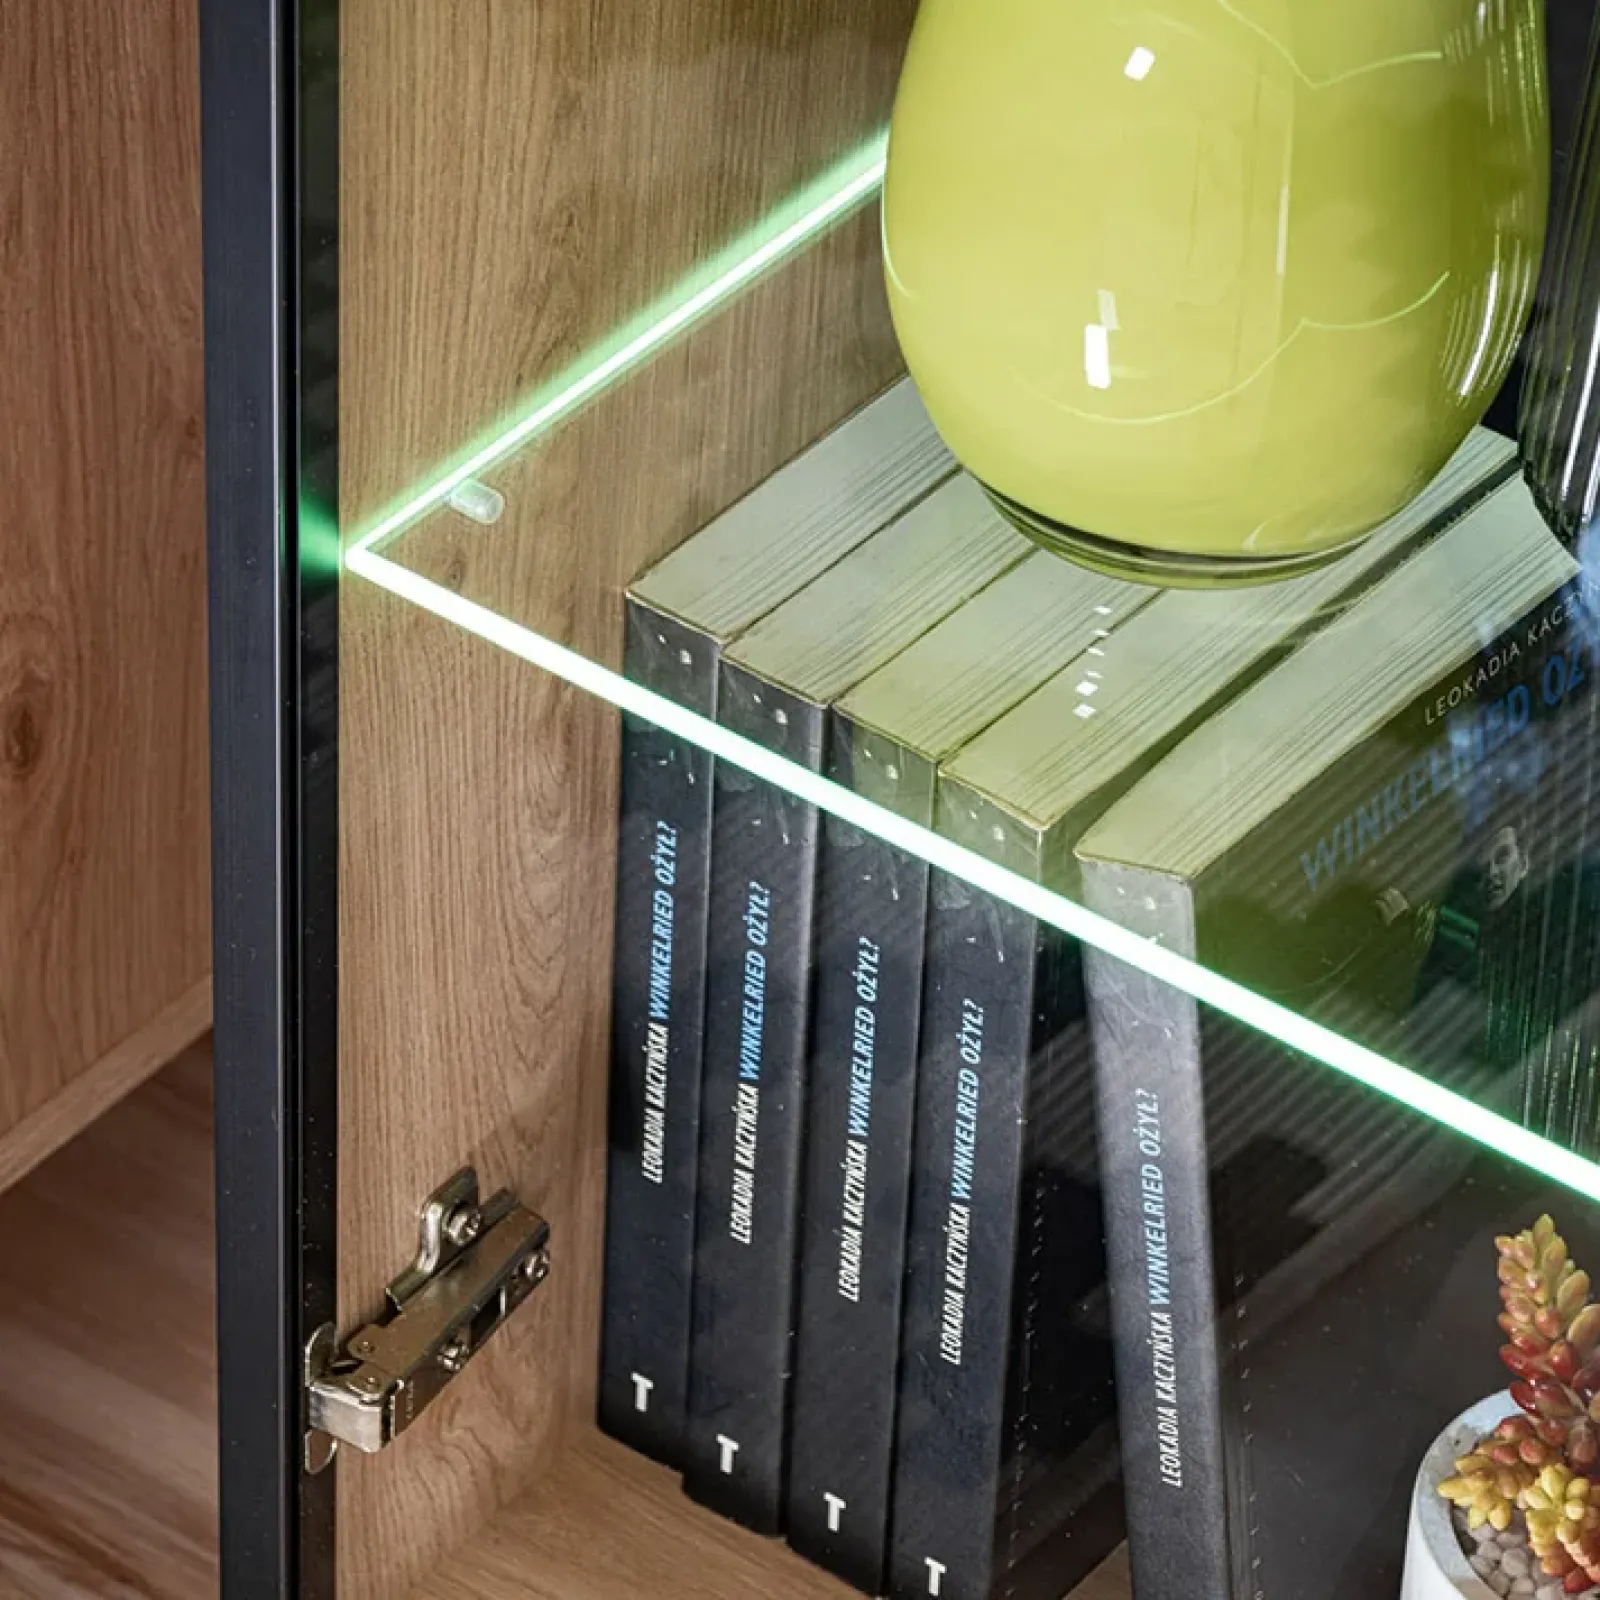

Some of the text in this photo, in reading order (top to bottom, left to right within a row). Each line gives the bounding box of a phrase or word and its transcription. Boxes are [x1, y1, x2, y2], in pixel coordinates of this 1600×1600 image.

[1425, 641, 1520, 726] LEOKADIA
[649, 889, 674, 1019] WINKELRIED
[739, 949, 766, 1080] WINKELRIED
[642, 1022, 670, 1109] KACZYŃSKA
[848, 1005, 876, 1136] WINKELRIED
[641, 1107, 665, 1184] LEOKADIA
[731, 1083, 760, 1170] KACZYŃSKA
[951, 1067, 979, 1200] WINKELRIED
[729, 1168, 755, 1245] LEOKADIA
[840, 1139, 868, 1227] KACZYŃSKA
[838, 1224, 863, 1303] LEOKADIA
[942, 1202, 971, 1289] KACZYŃSKA
[1141, 1163, 1170, 1304] WINKELRIED
[939, 1287, 964, 1366] LEOKADIA
[1146, 1312, 1177, 1403] KACZYŃSKA
[631, 1371, 654, 1412] T
[716, 1433, 739, 1474] T
[1157, 1406, 1183, 1488] LEOKADIA
[823, 1491, 847, 1532] T
[924, 1556, 948, 1597] T
